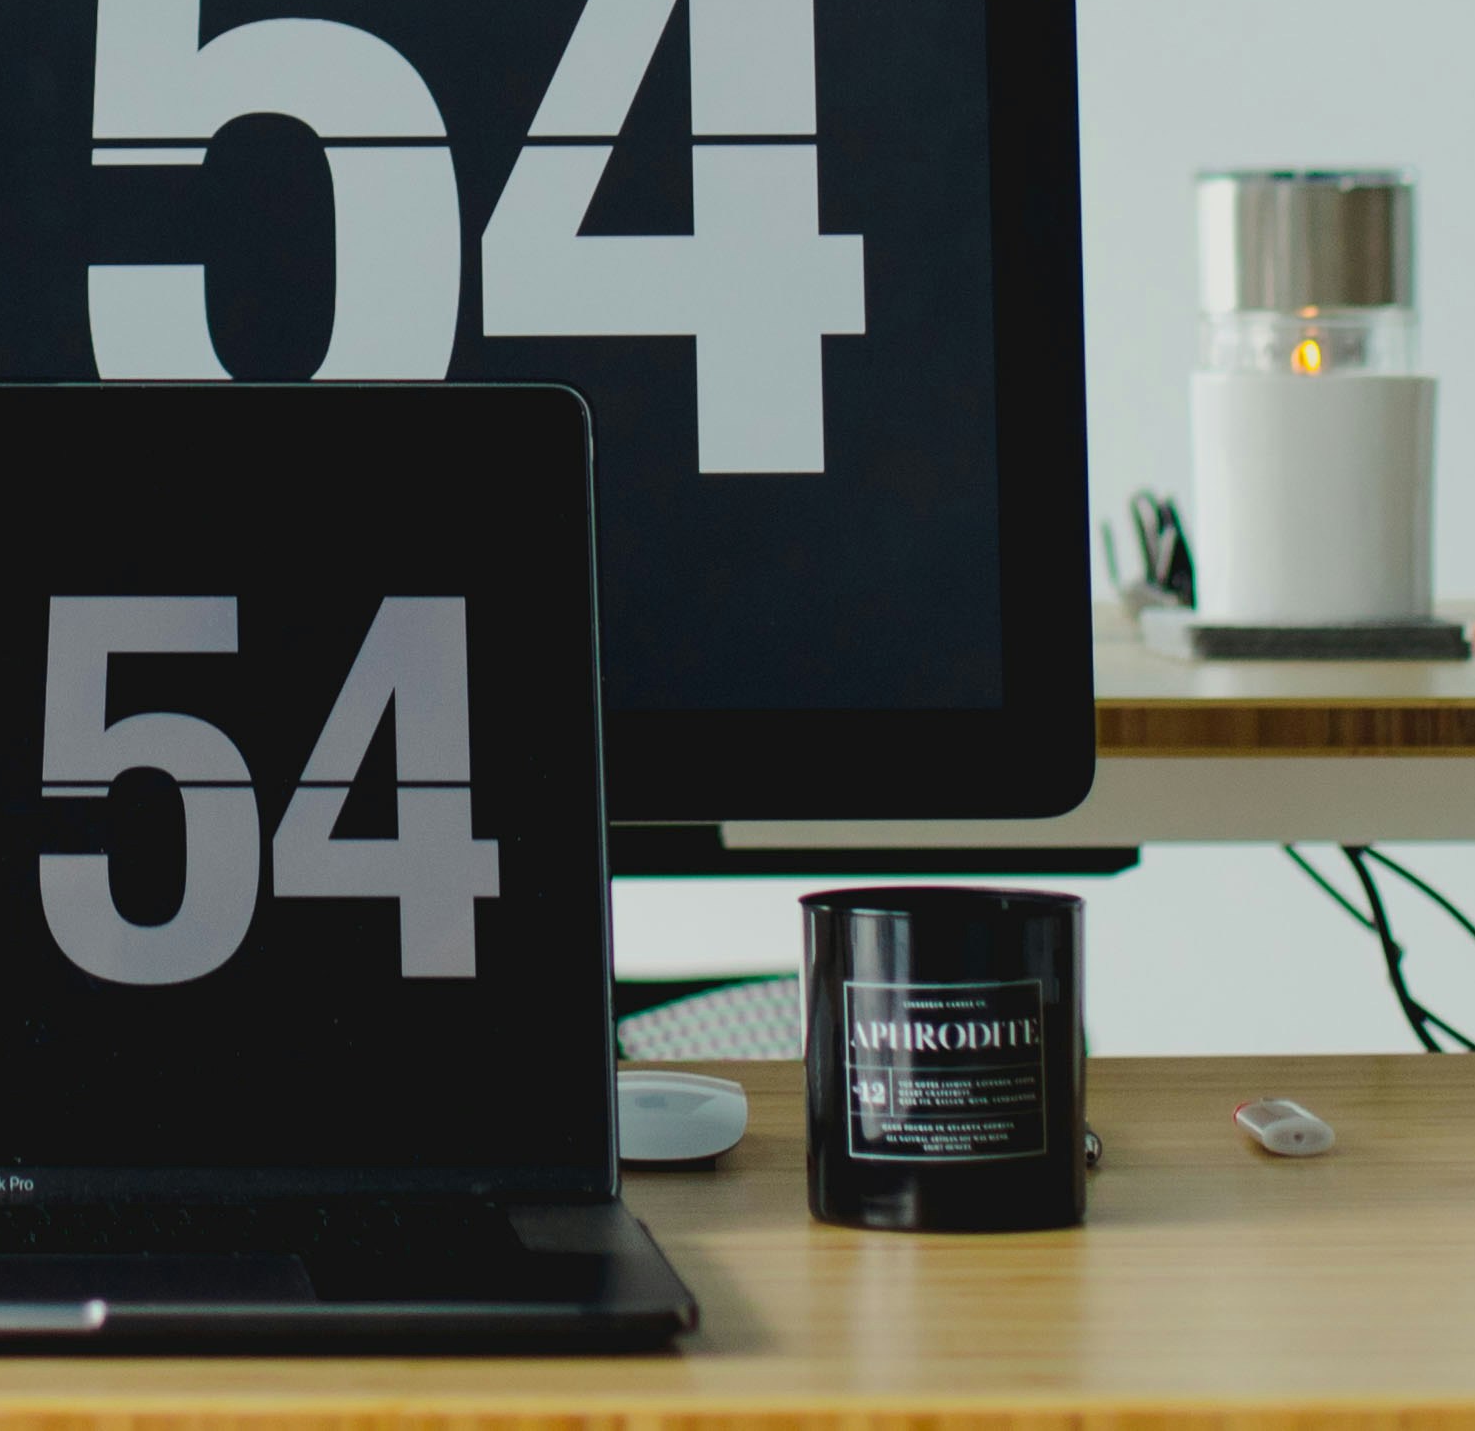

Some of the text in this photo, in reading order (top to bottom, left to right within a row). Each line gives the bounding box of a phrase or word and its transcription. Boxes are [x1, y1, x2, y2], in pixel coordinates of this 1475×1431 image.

[39, 596, 500, 985] 54
[851, 1019, 1040, 1051] APHRODITE
[10, 1176, 34, 1192] Pro
